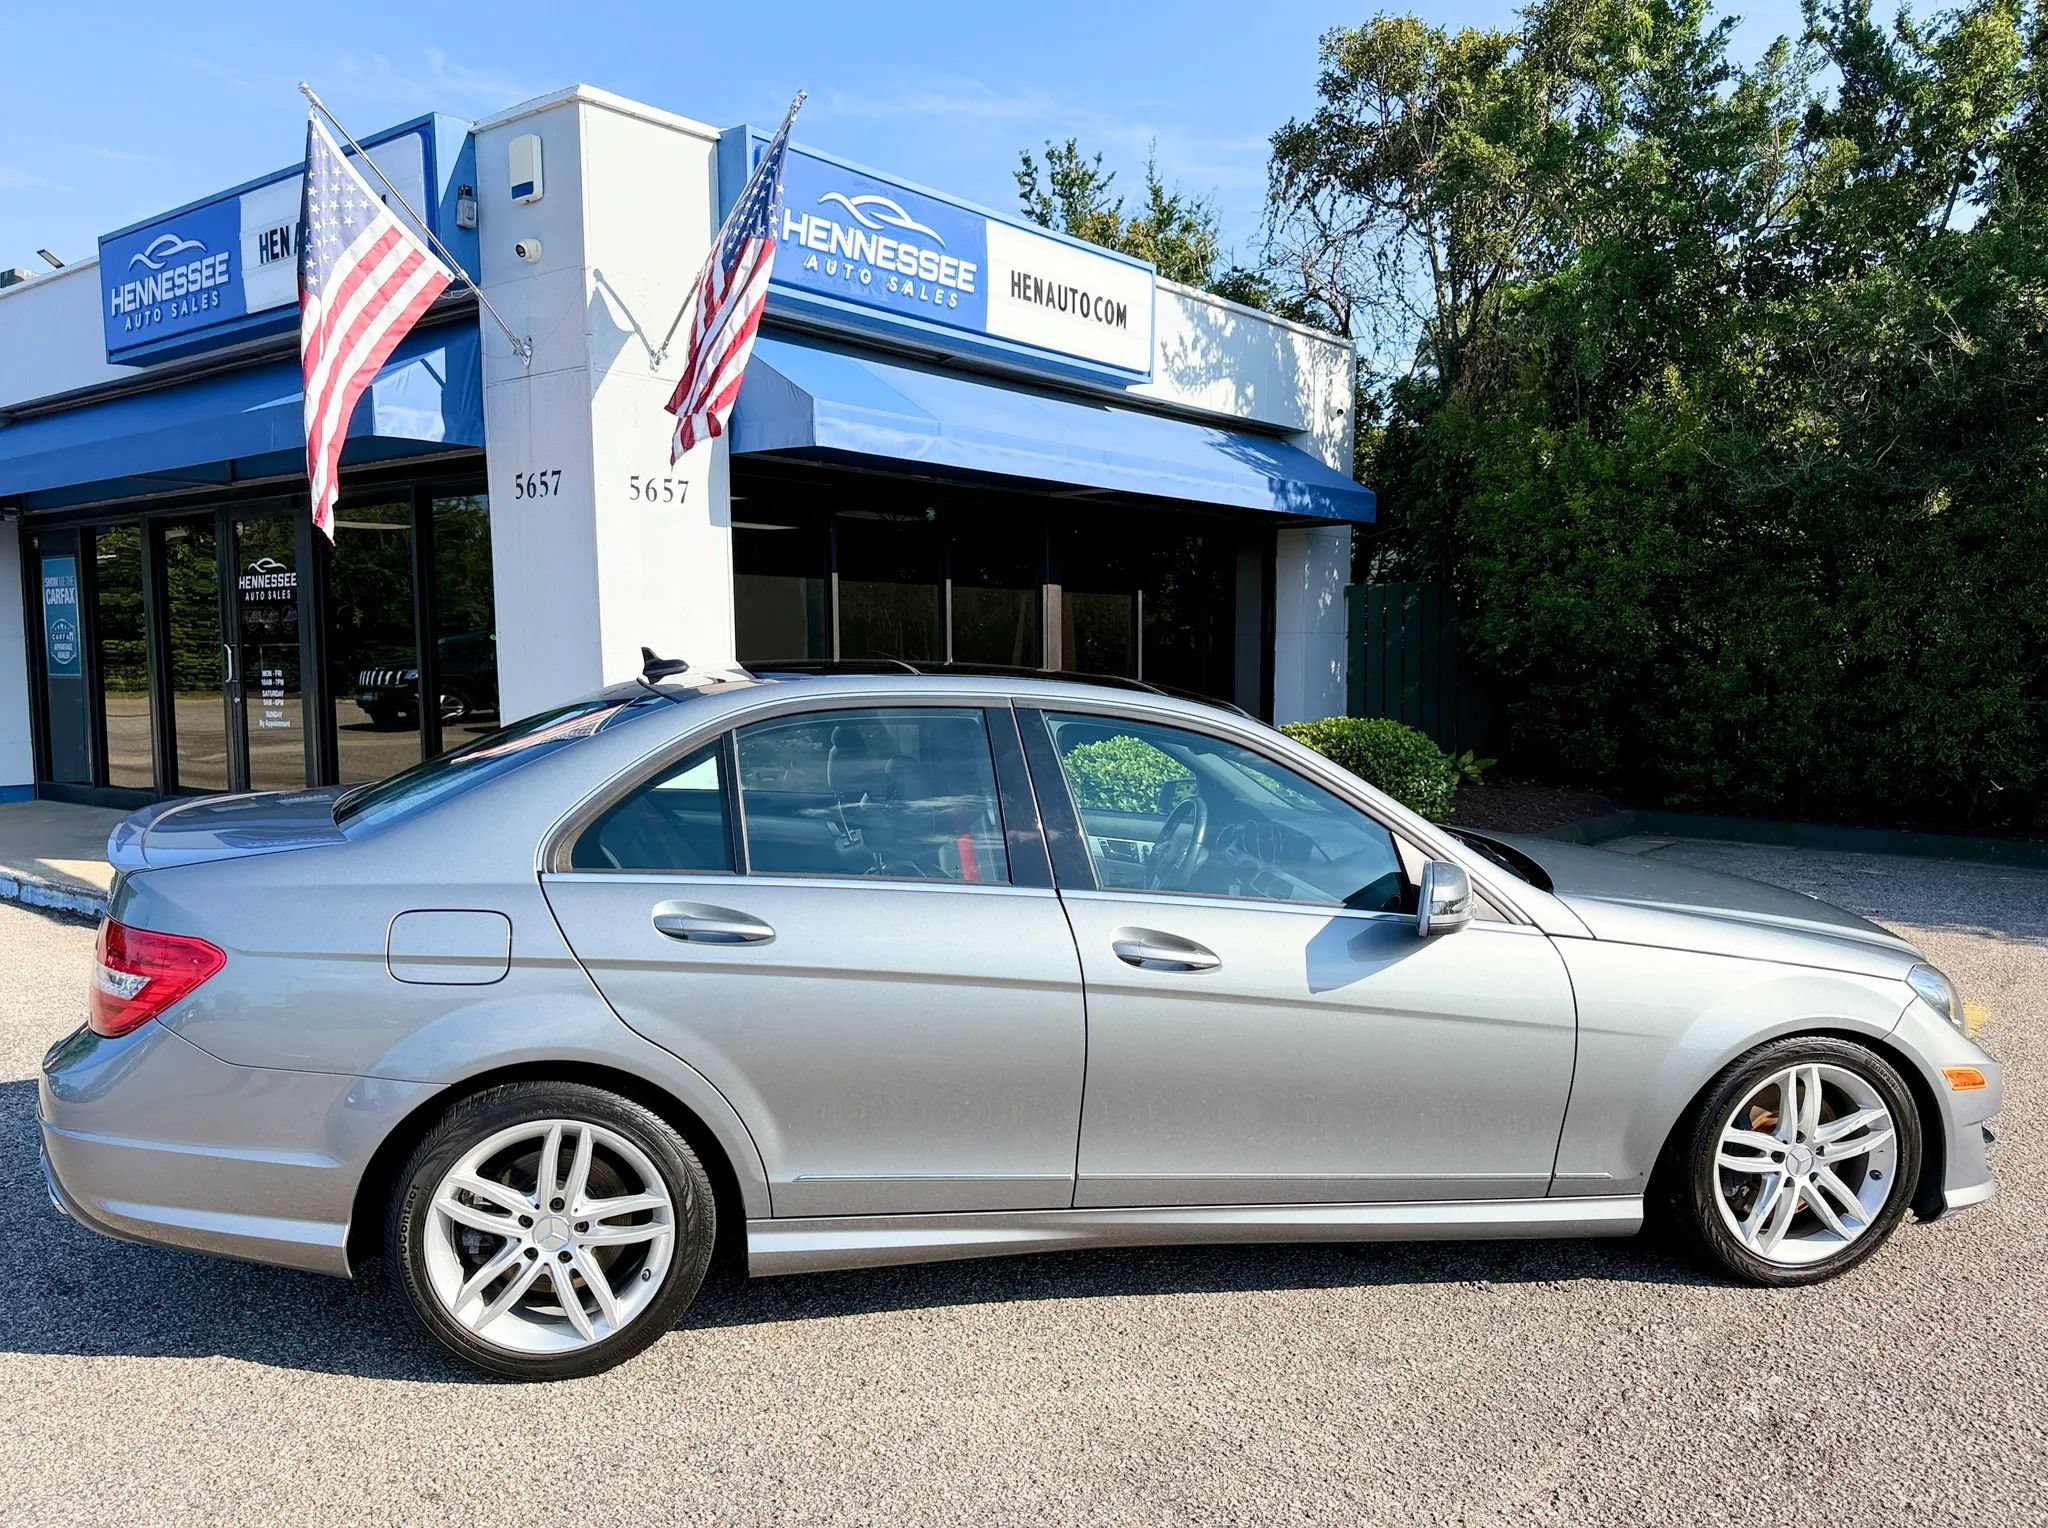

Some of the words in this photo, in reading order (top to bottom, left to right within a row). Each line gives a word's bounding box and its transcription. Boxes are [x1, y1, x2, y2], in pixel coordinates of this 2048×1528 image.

[781, 207, 977, 293] HENNESSEE
[111, 252, 229, 316] HENNESSEE
[804, 253, 872, 285] AUTO
[887, 275, 959, 309] SALES
[125, 308, 162, 331] AUTO
[171, 290, 219, 318] SALES
[515, 469, 562, 500] 5657
[629, 475, 689, 504] 5657
[46, 588, 75, 605] CARFAX
[239, 573, 297, 590] HENNESSEE
[245, 591, 265, 601] AUTO
[268, 590, 291, 600] SALES
